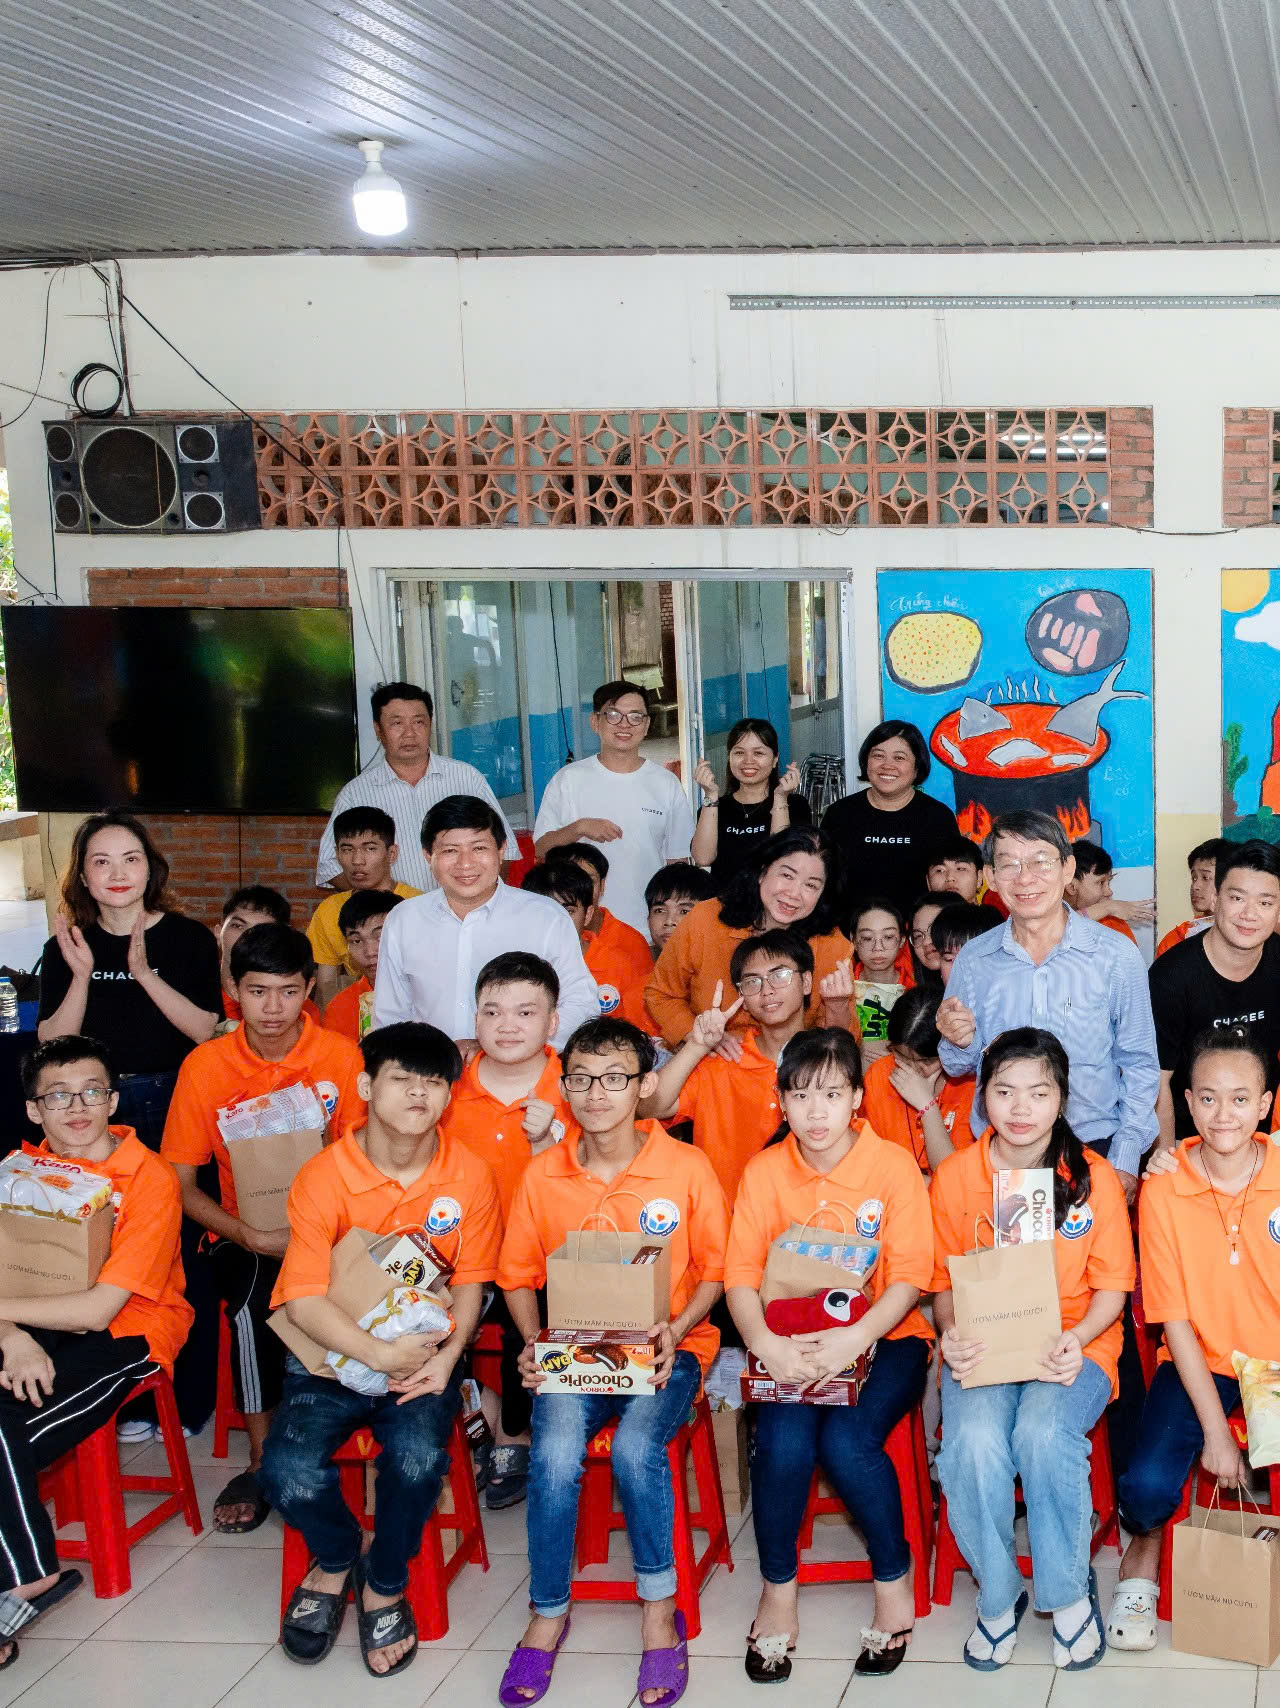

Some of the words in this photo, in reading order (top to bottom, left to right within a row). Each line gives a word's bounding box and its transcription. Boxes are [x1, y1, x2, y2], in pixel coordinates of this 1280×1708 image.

[864, 836, 911, 844] CHAGEE
[560, 1374, 634, 1388] ChocoPie
[377, 1612, 399, 1628] NIKE
